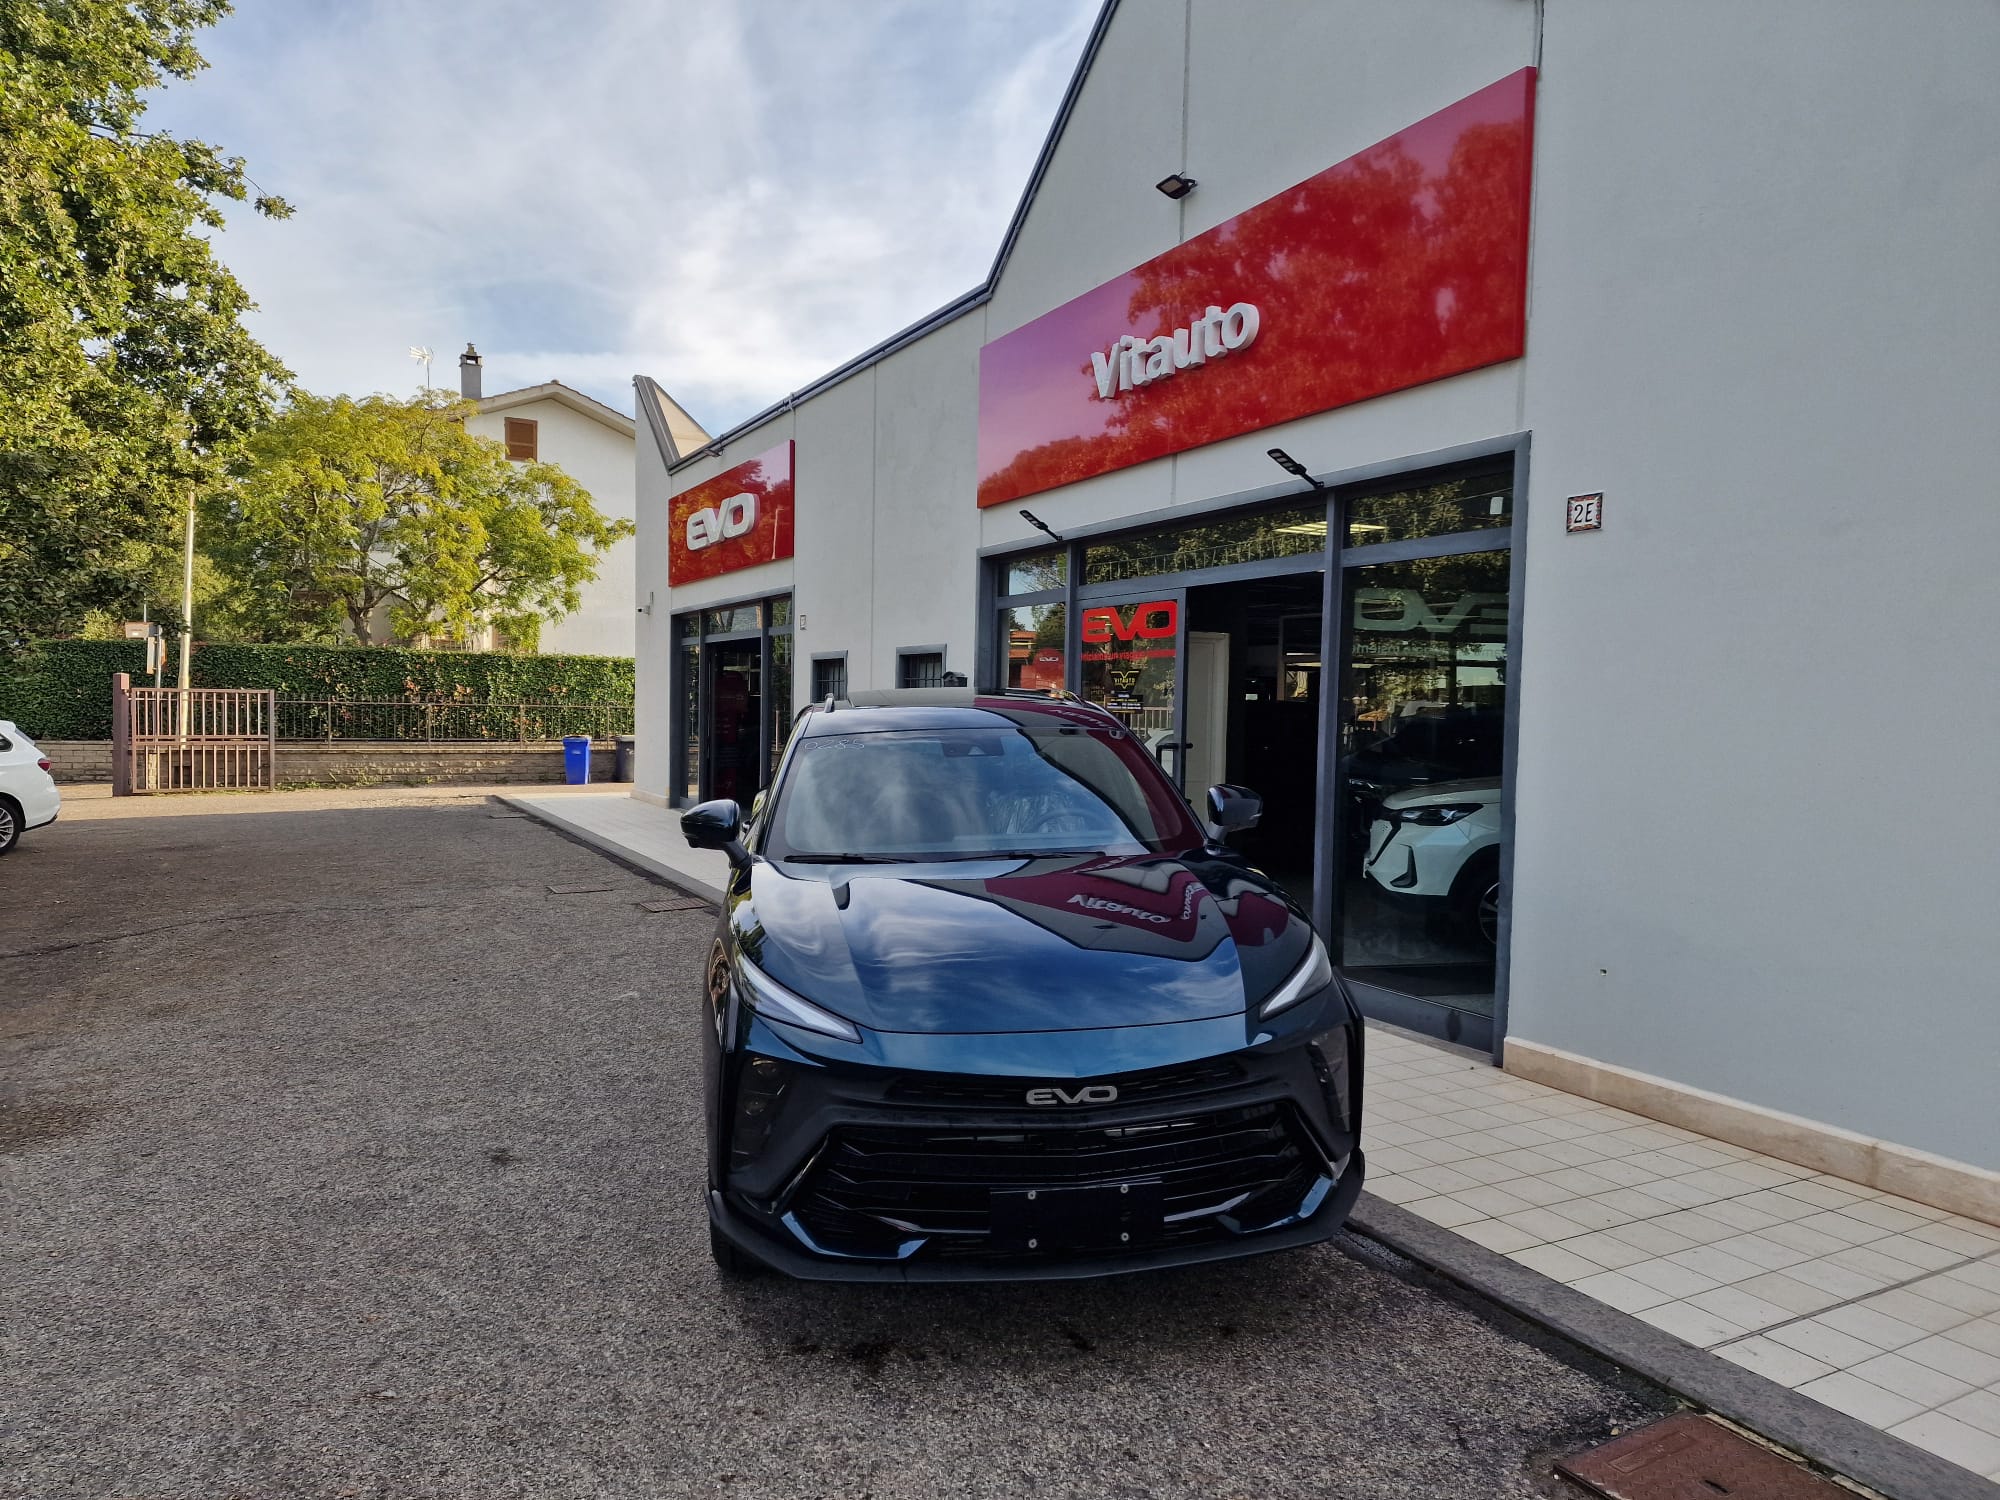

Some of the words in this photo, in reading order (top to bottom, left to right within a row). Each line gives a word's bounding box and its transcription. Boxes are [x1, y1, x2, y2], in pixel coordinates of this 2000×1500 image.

[1090, 301, 1260, 399] Vitauto
[686, 492, 759, 551] EVO
[1574, 502, 1595, 524] 2E
[1082, 600, 1178, 643] EVO
[1026, 1085, 1118, 1105] EVO
